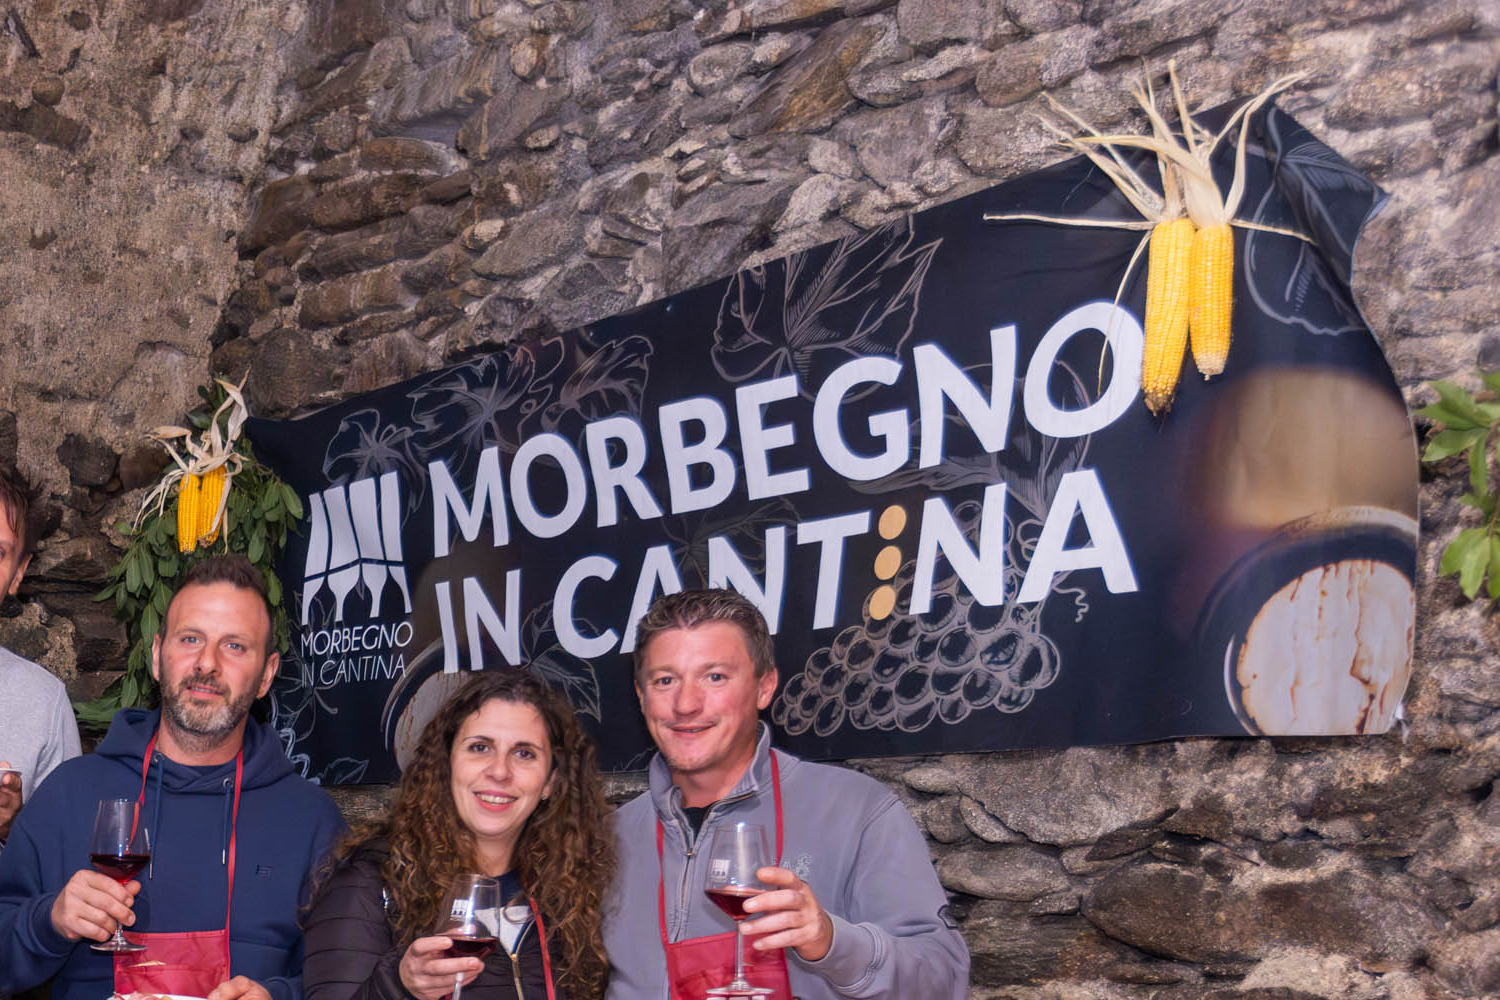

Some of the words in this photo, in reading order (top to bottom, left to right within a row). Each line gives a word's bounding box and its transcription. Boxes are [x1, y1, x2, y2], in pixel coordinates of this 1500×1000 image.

[428, 301, 1145, 558] MORBEGNO
[301, 621, 414, 657] MORBEGNO
[435, 568, 522, 675] IN
[301, 662, 315, 688] IN
[320, 654, 407, 685] CANTINA
